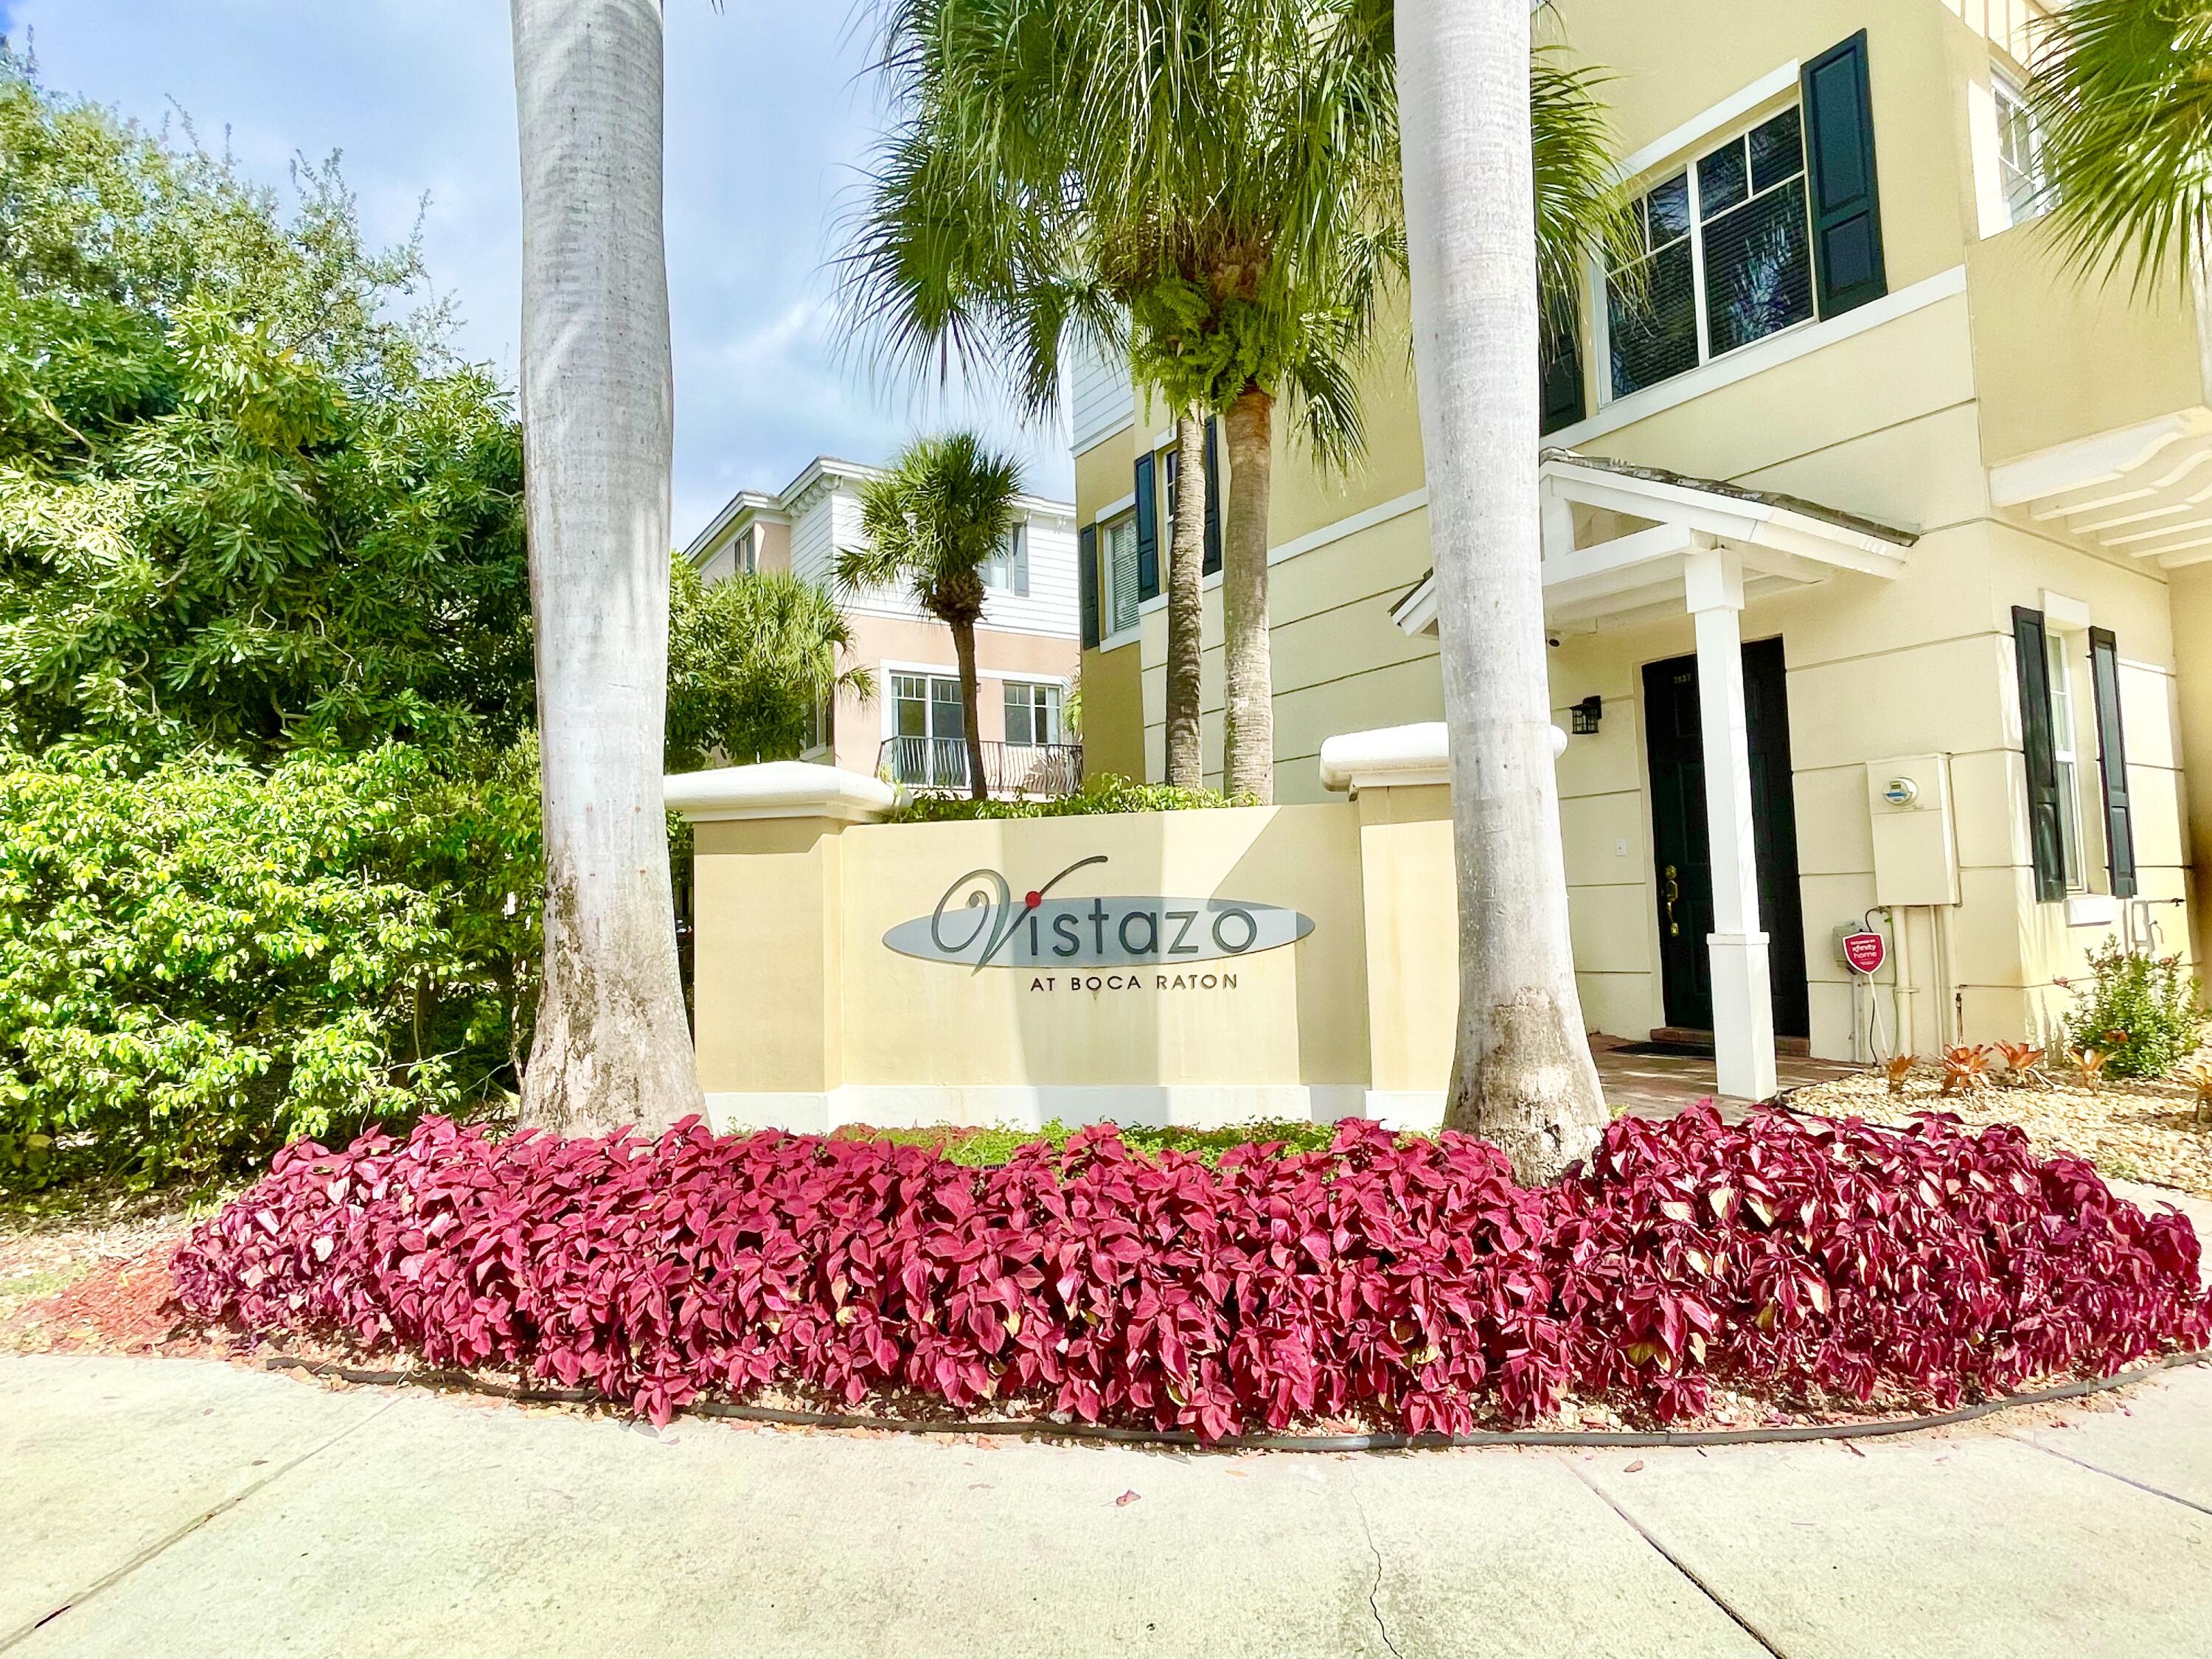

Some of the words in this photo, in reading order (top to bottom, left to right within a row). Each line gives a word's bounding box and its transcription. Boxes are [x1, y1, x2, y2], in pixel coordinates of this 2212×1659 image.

[931, 855, 1257, 977] Vistazo
[1031, 977, 1056, 991] AT
[1071, 975, 1141, 992] BOCA
[1156, 973, 1237, 990] RATON
